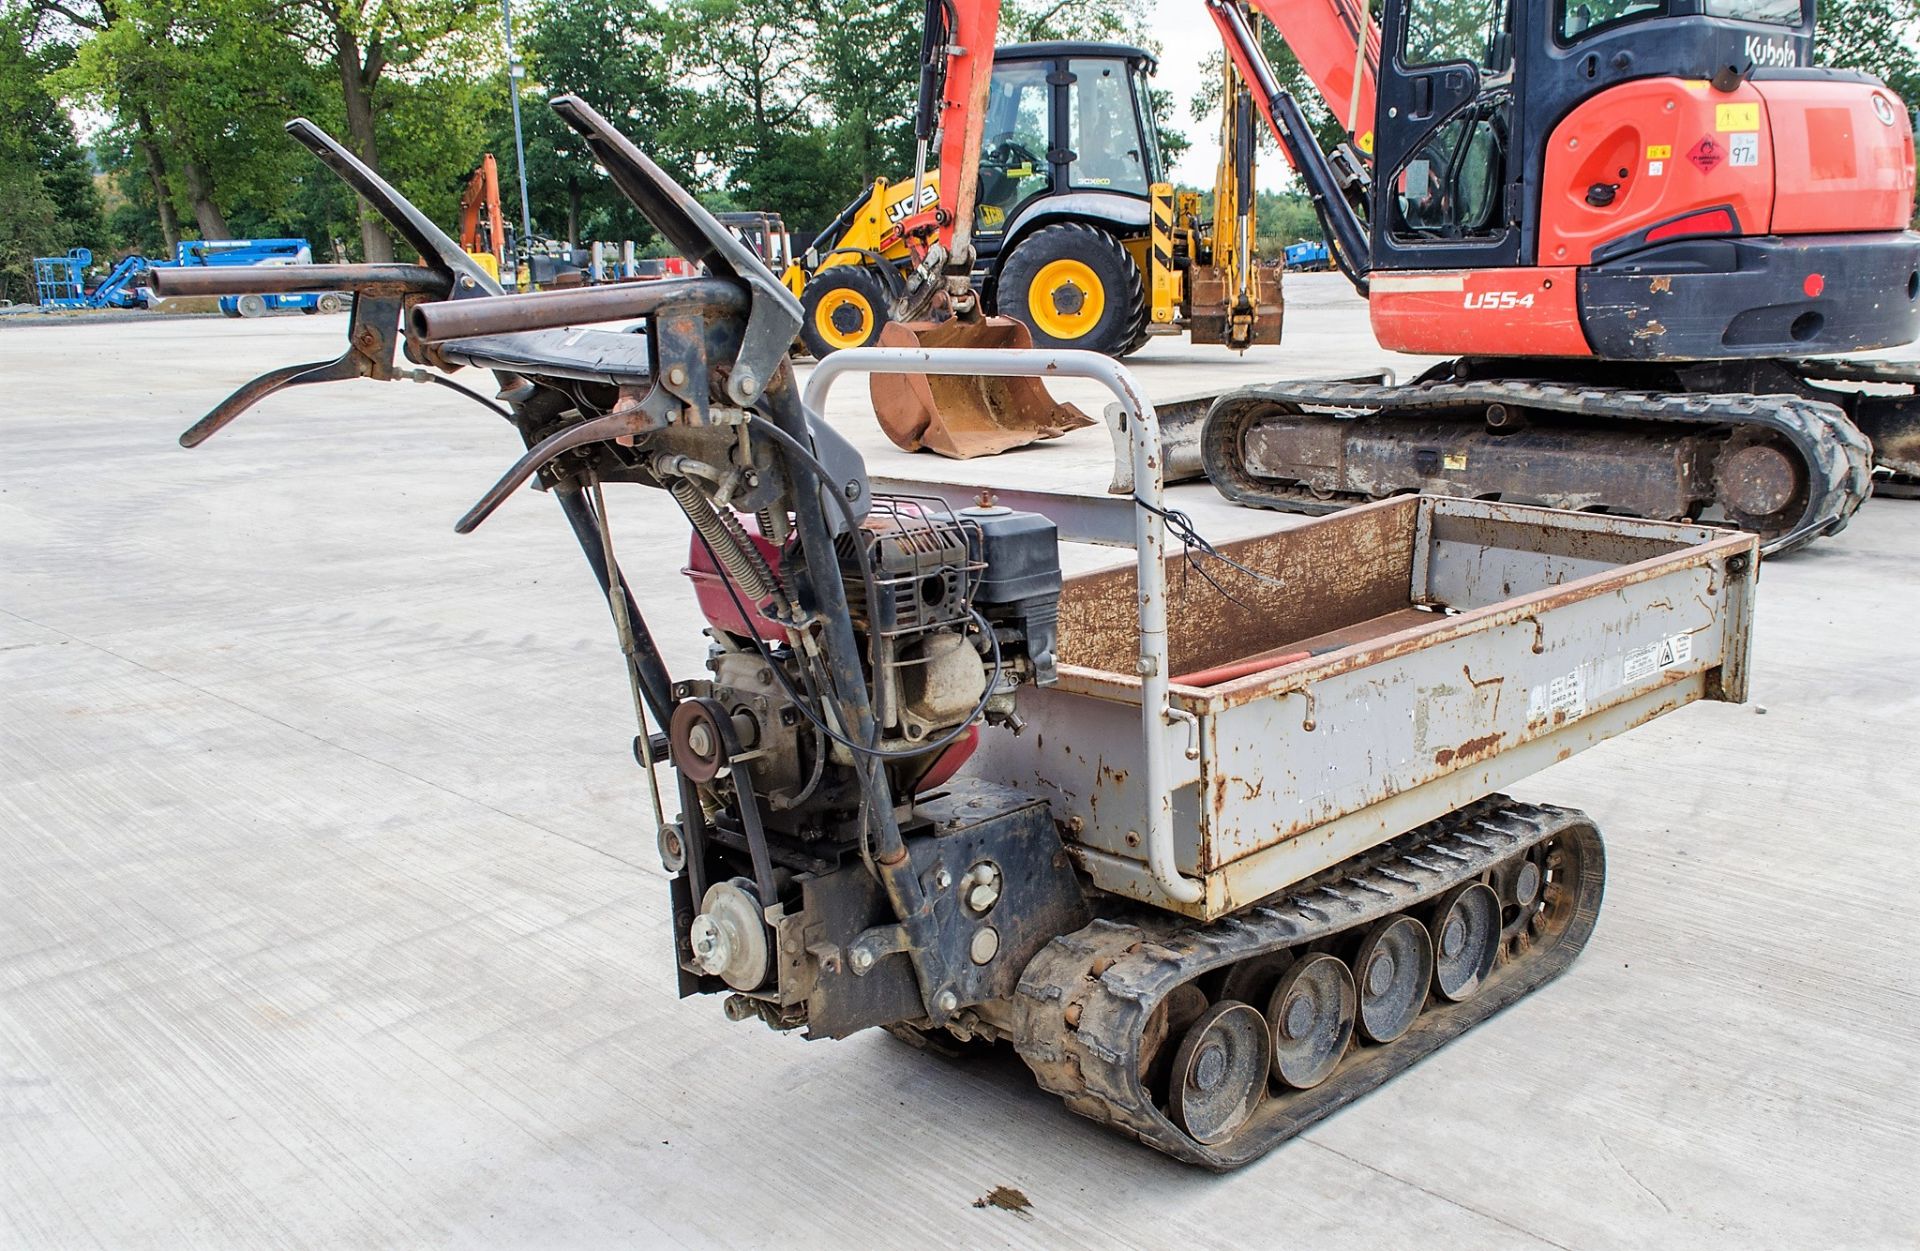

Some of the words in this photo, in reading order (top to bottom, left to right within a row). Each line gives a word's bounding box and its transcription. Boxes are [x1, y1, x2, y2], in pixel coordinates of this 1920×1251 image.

[1744, 35, 1796, 68] Kubota
[1732, 147, 1750, 163] 97
[886, 184, 940, 223] JCB
[1463, 291, 1535, 310] U55-4
